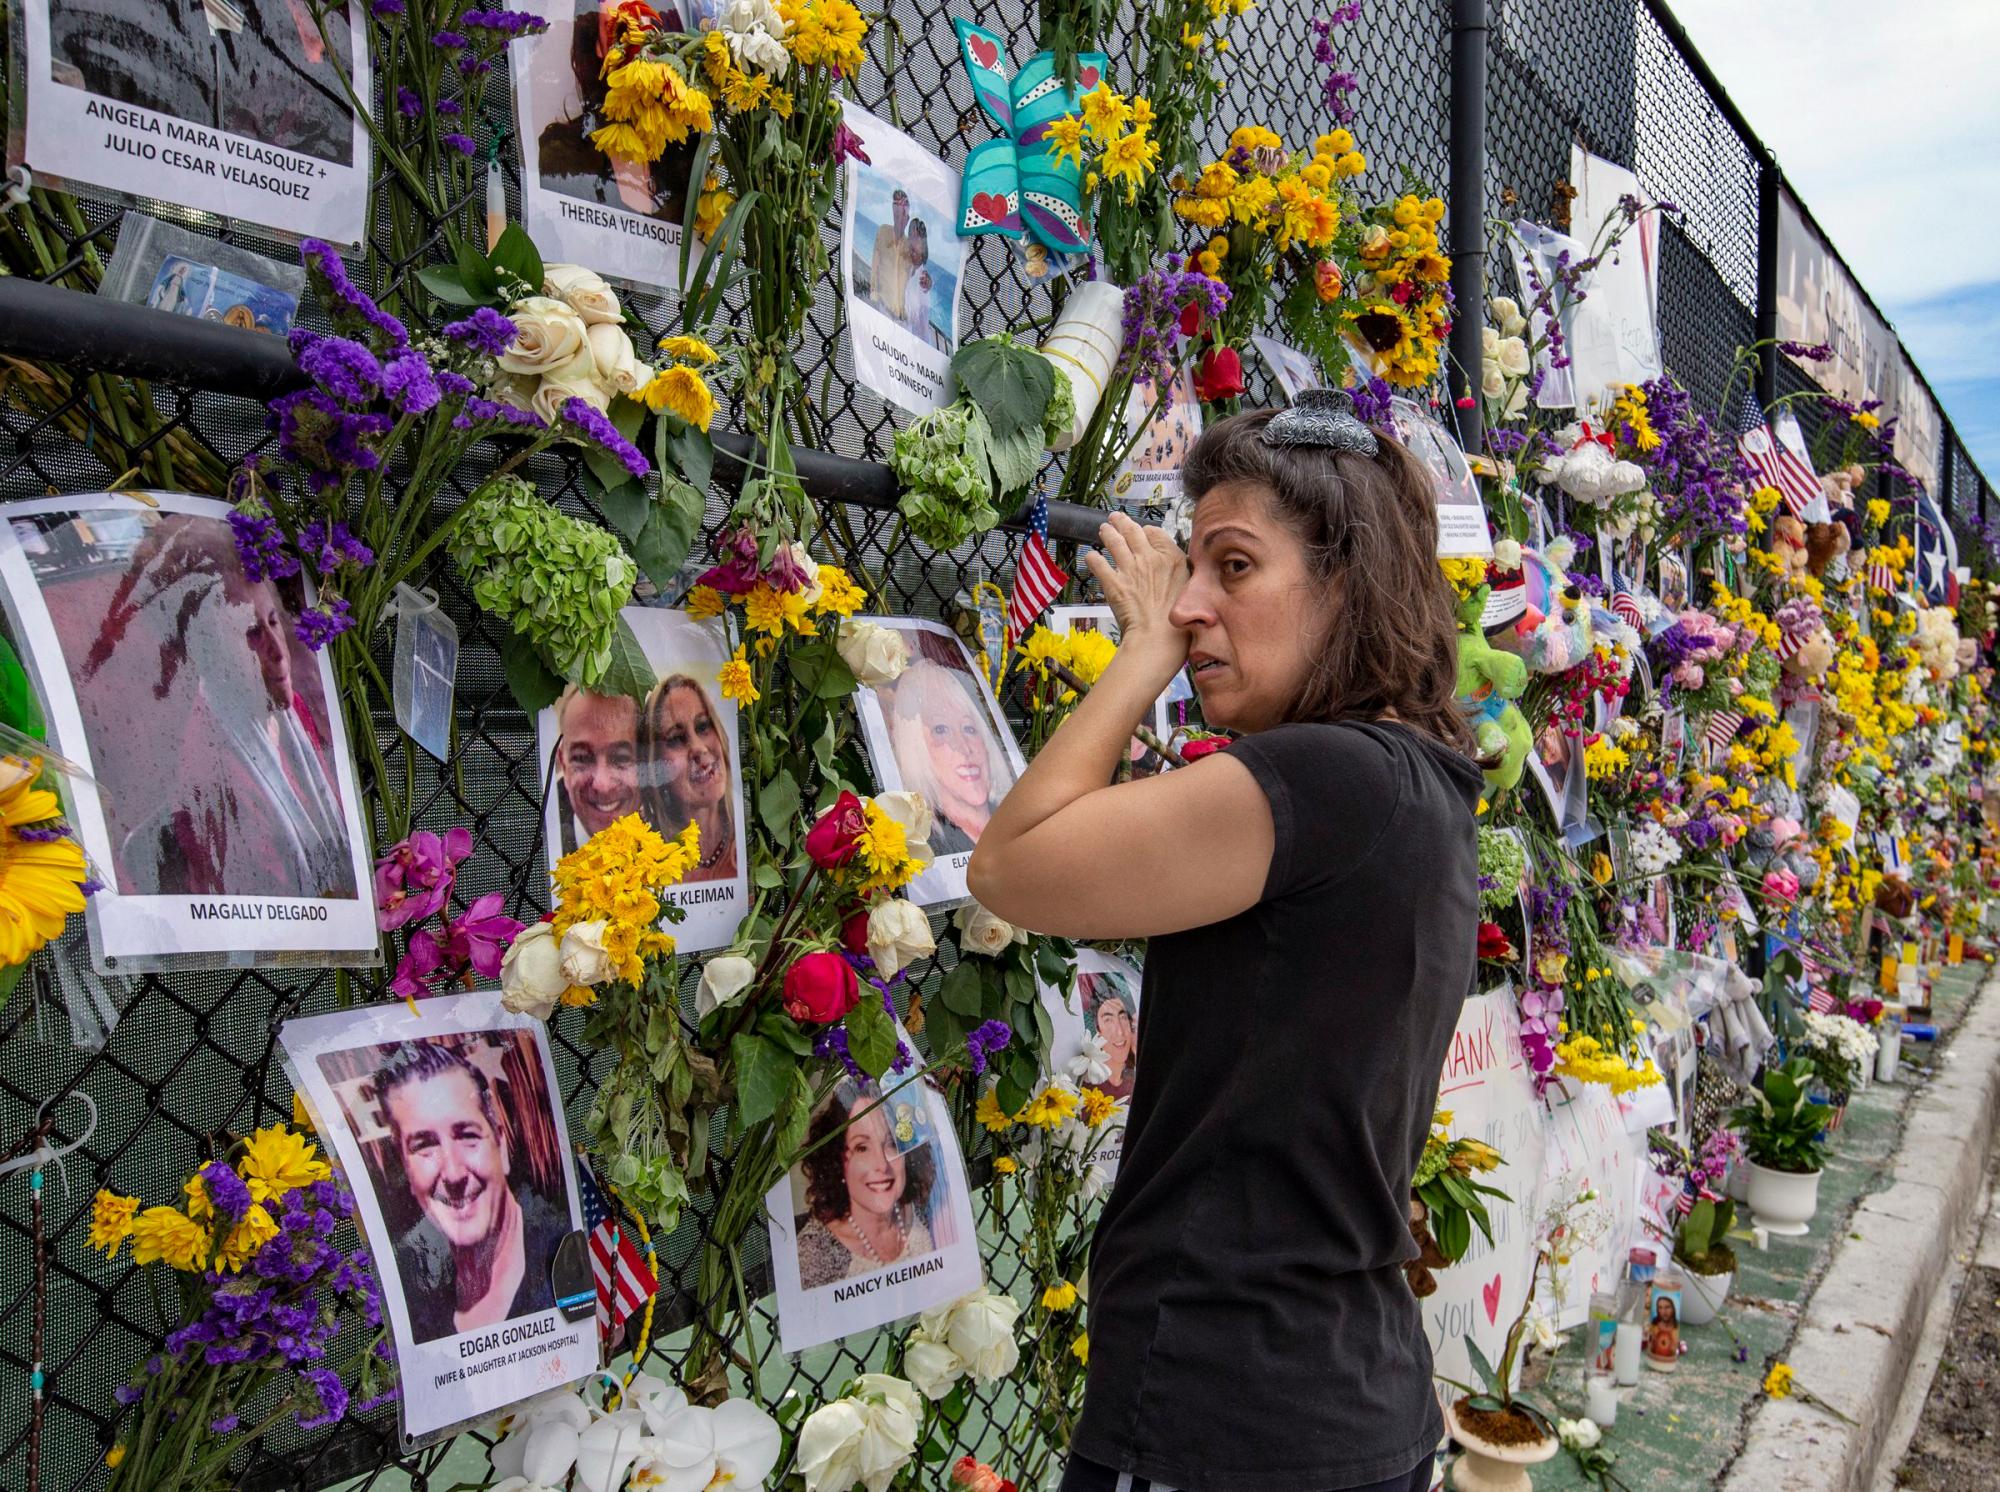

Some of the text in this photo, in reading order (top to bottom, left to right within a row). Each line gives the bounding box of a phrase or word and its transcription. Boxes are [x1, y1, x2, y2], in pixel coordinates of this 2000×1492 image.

[86, 100, 161, 135] ANGELA
[167, 122, 220, 151] MARA
[225, 138, 314, 177] VELASQUEZ
[105, 133, 310, 201] JULIO CESAR VELASQUEZ
[559, 200, 682, 246] THERESA VELASQUE
[872, 334, 908, 366] CLAUDIO
[916, 362, 944, 388] MARIA
[888, 365, 933, 400] BONNEFOY
[952, 855, 970, 869] ELA
[190, 903, 327, 921] MAGALLY DELGADO
[680, 886, 734, 906] KLEIMAN
[1441, 1004, 1497, 1082] ANK
[1100, 1149, 1122, 1161] ROD
[834, 1257, 944, 1303] NANCY KLEIMAN
[459, 1317, 555, 1358] EDGAR GONZALEZ
[434, 1333, 579, 1389] (WIFE & DAUGHTER AT JACKSON HOSPITAL)
